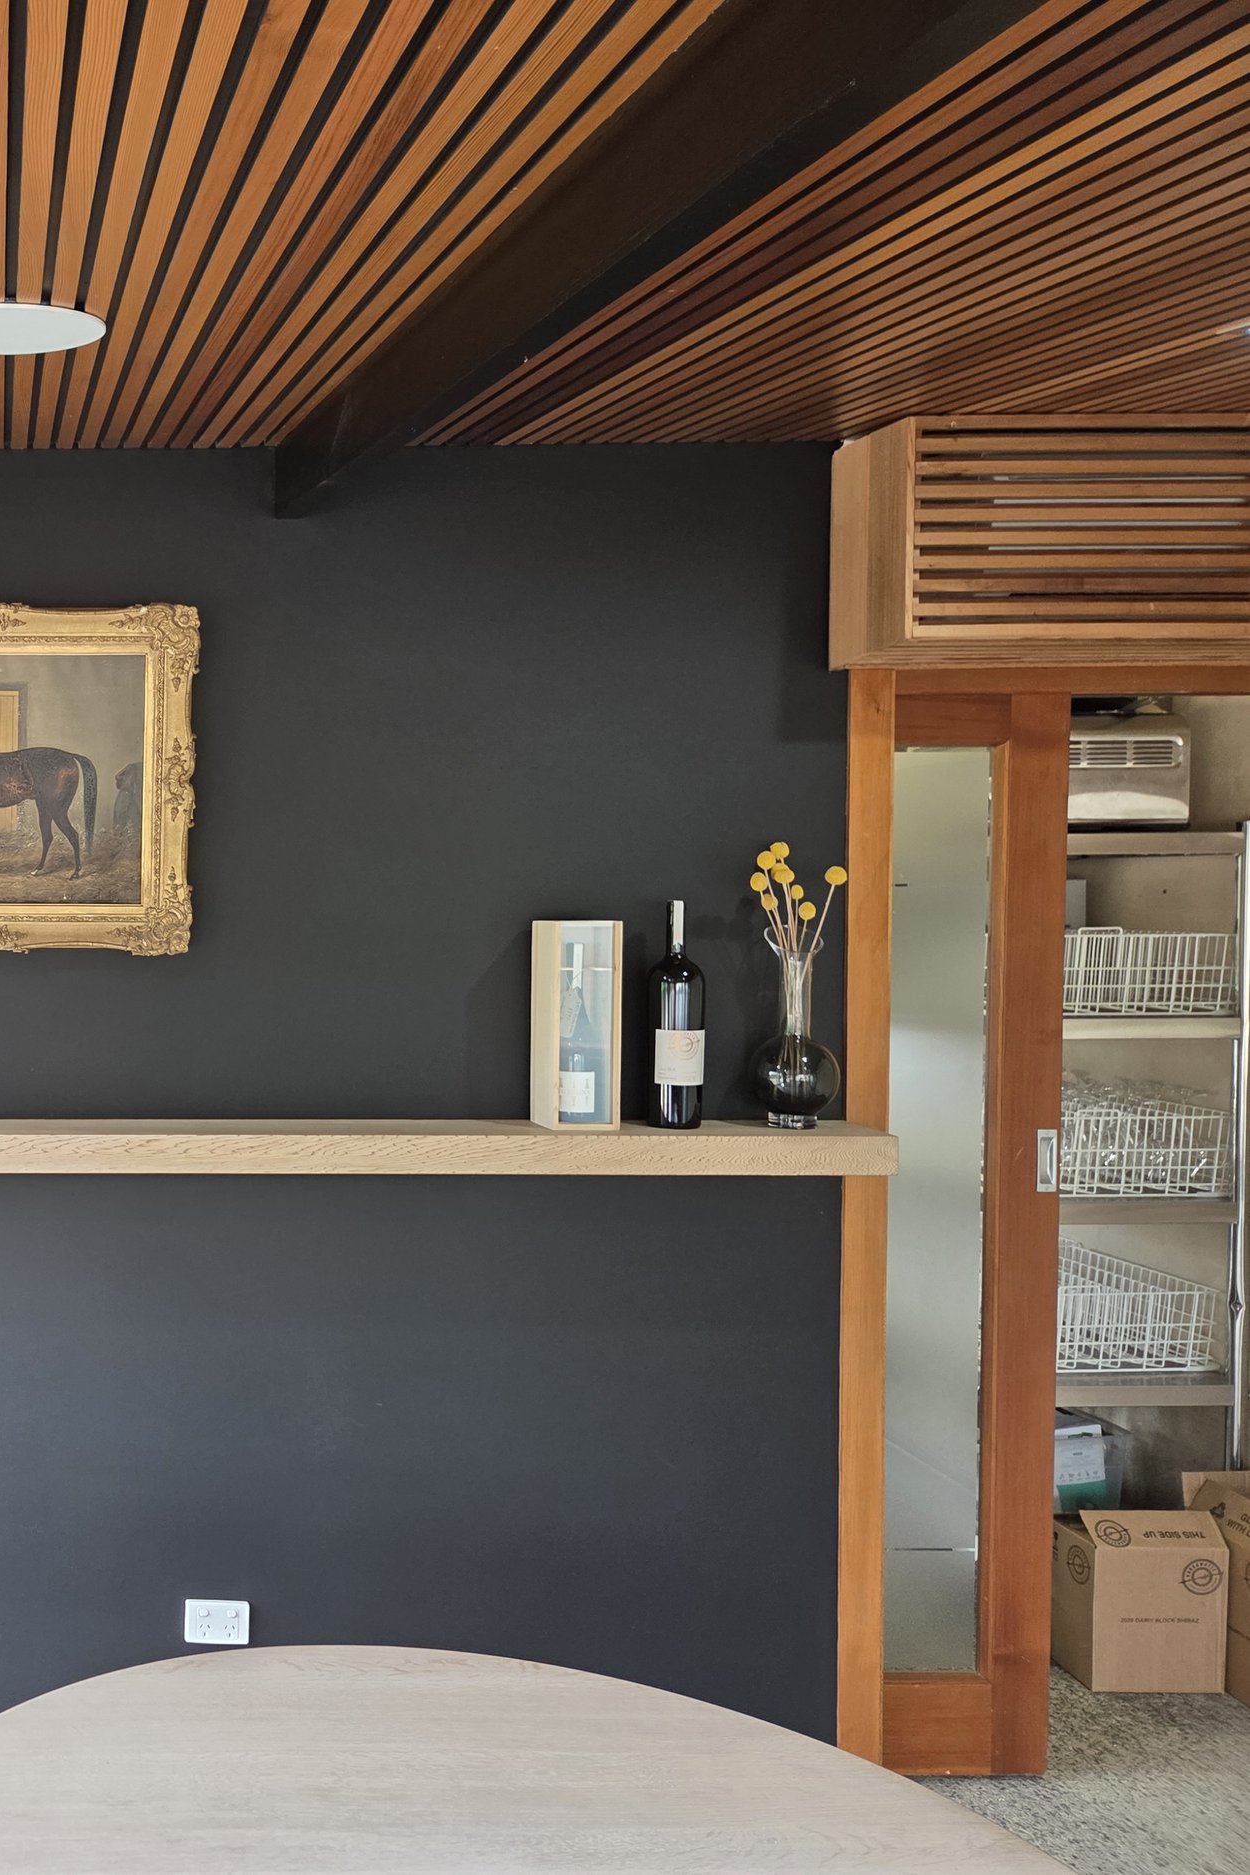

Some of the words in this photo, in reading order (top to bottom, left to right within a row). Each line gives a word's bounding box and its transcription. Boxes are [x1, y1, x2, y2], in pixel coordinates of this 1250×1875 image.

[1226, 1518, 1247, 1534] WITH
[1143, 1530, 1157, 1539] UP
[1158, 1530, 1181, 1539] SIDE
[1182, 1530, 1206, 1539] THIS
